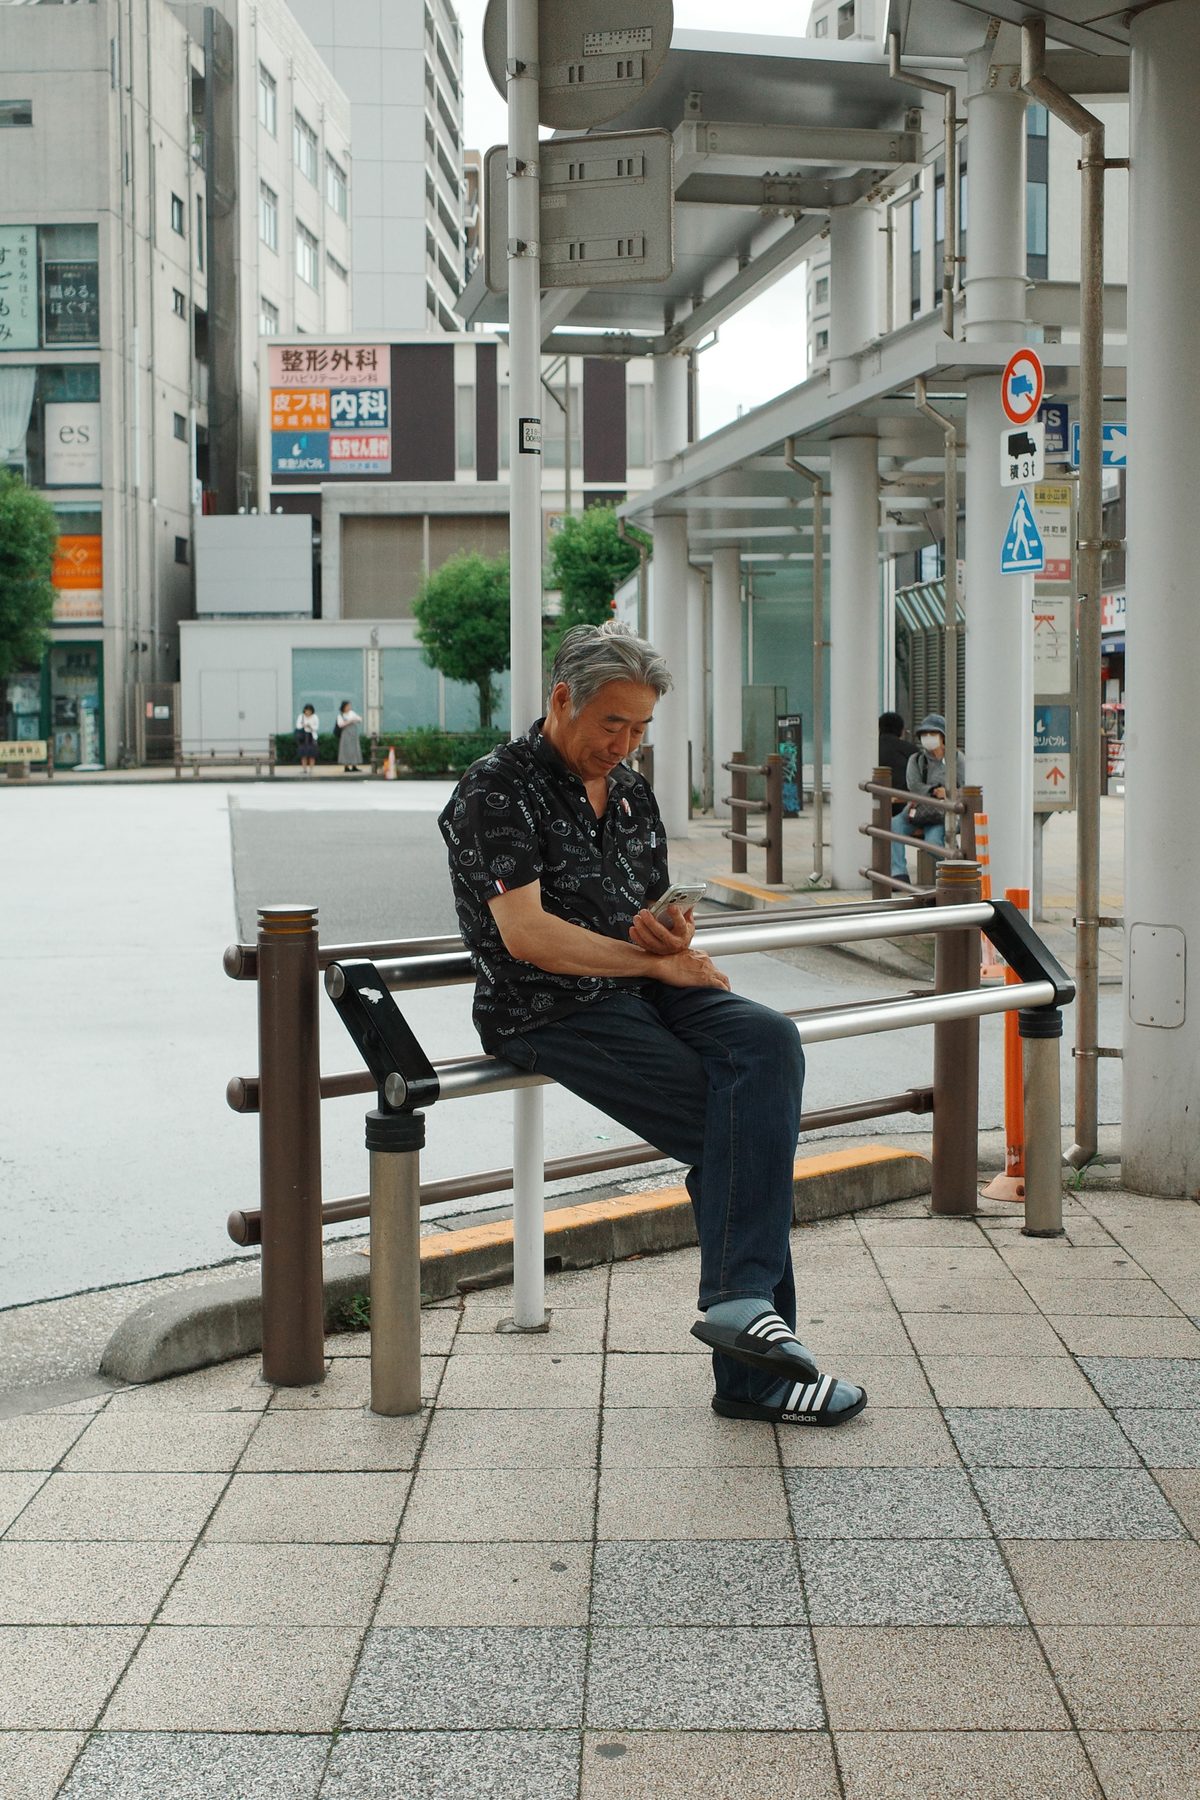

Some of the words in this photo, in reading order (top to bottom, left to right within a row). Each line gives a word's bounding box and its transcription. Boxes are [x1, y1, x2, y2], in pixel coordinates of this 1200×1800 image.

[281, 348, 378, 372] 整形外科
[281, 374, 378, 384] リハビリテーション科
[273, 393, 327, 411] 皮フ科
[330, 390, 387, 420] 内科
[59, 425, 90, 444] es
[1039, 525, 1068, 534] 井町駅
[478, 956, 496, 985] PAGELO
[782, 1412, 818, 1422] adidas
